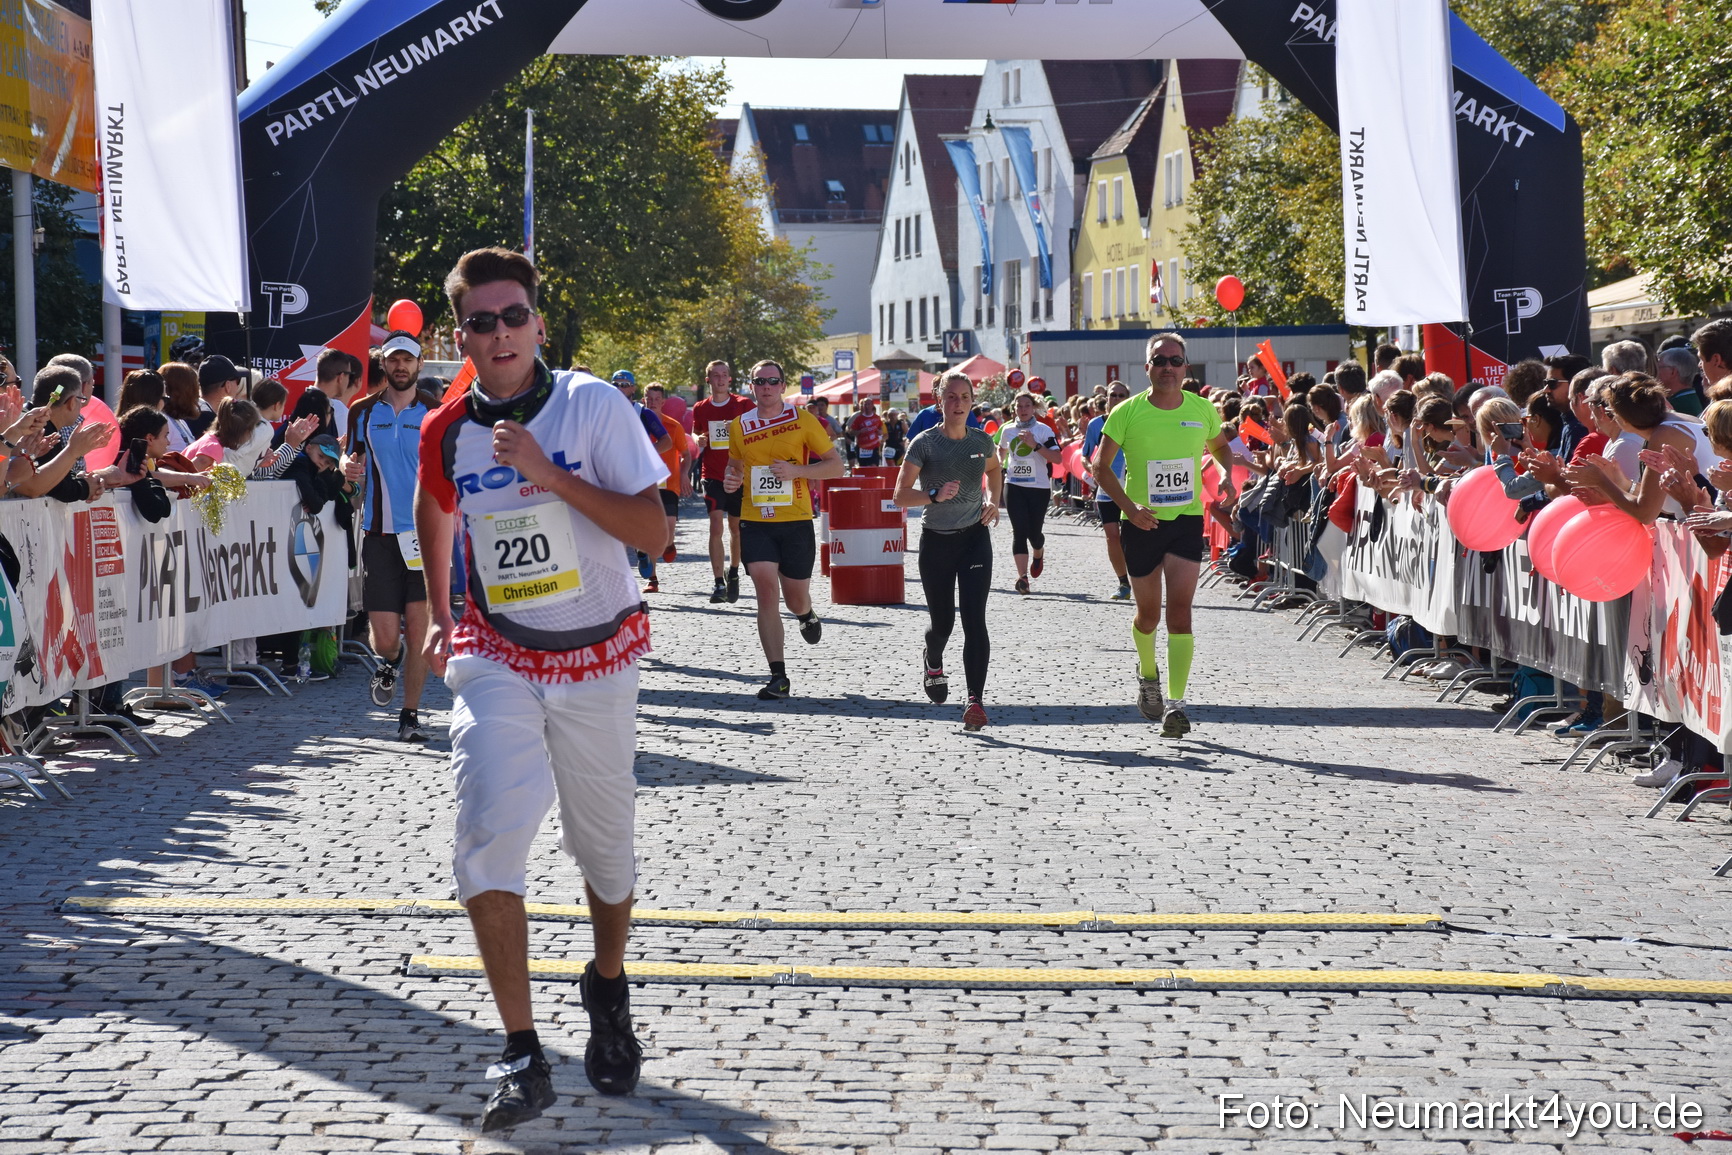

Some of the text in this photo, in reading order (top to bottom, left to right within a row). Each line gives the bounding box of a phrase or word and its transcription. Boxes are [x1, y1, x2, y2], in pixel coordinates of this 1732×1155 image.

[265, 0, 504, 147] PARTL NEUMARKT
[264, 358, 293, 369] NEXT
[1483, 365, 1505, 376] THE
[743, 423, 801, 446] MAX BÖGL
[1013, 465, 1032, 474] 2259
[759, 477, 783, 490] 259
[1155, 471, 1189, 488] 2164
[495, 514, 539, 532] BOCK
[494, 533, 551, 570] 220
[497, 567, 550, 581] PARTL Neumarkt
[503, 580, 559, 601] Christian
[541, 645, 601, 669] AVIA
